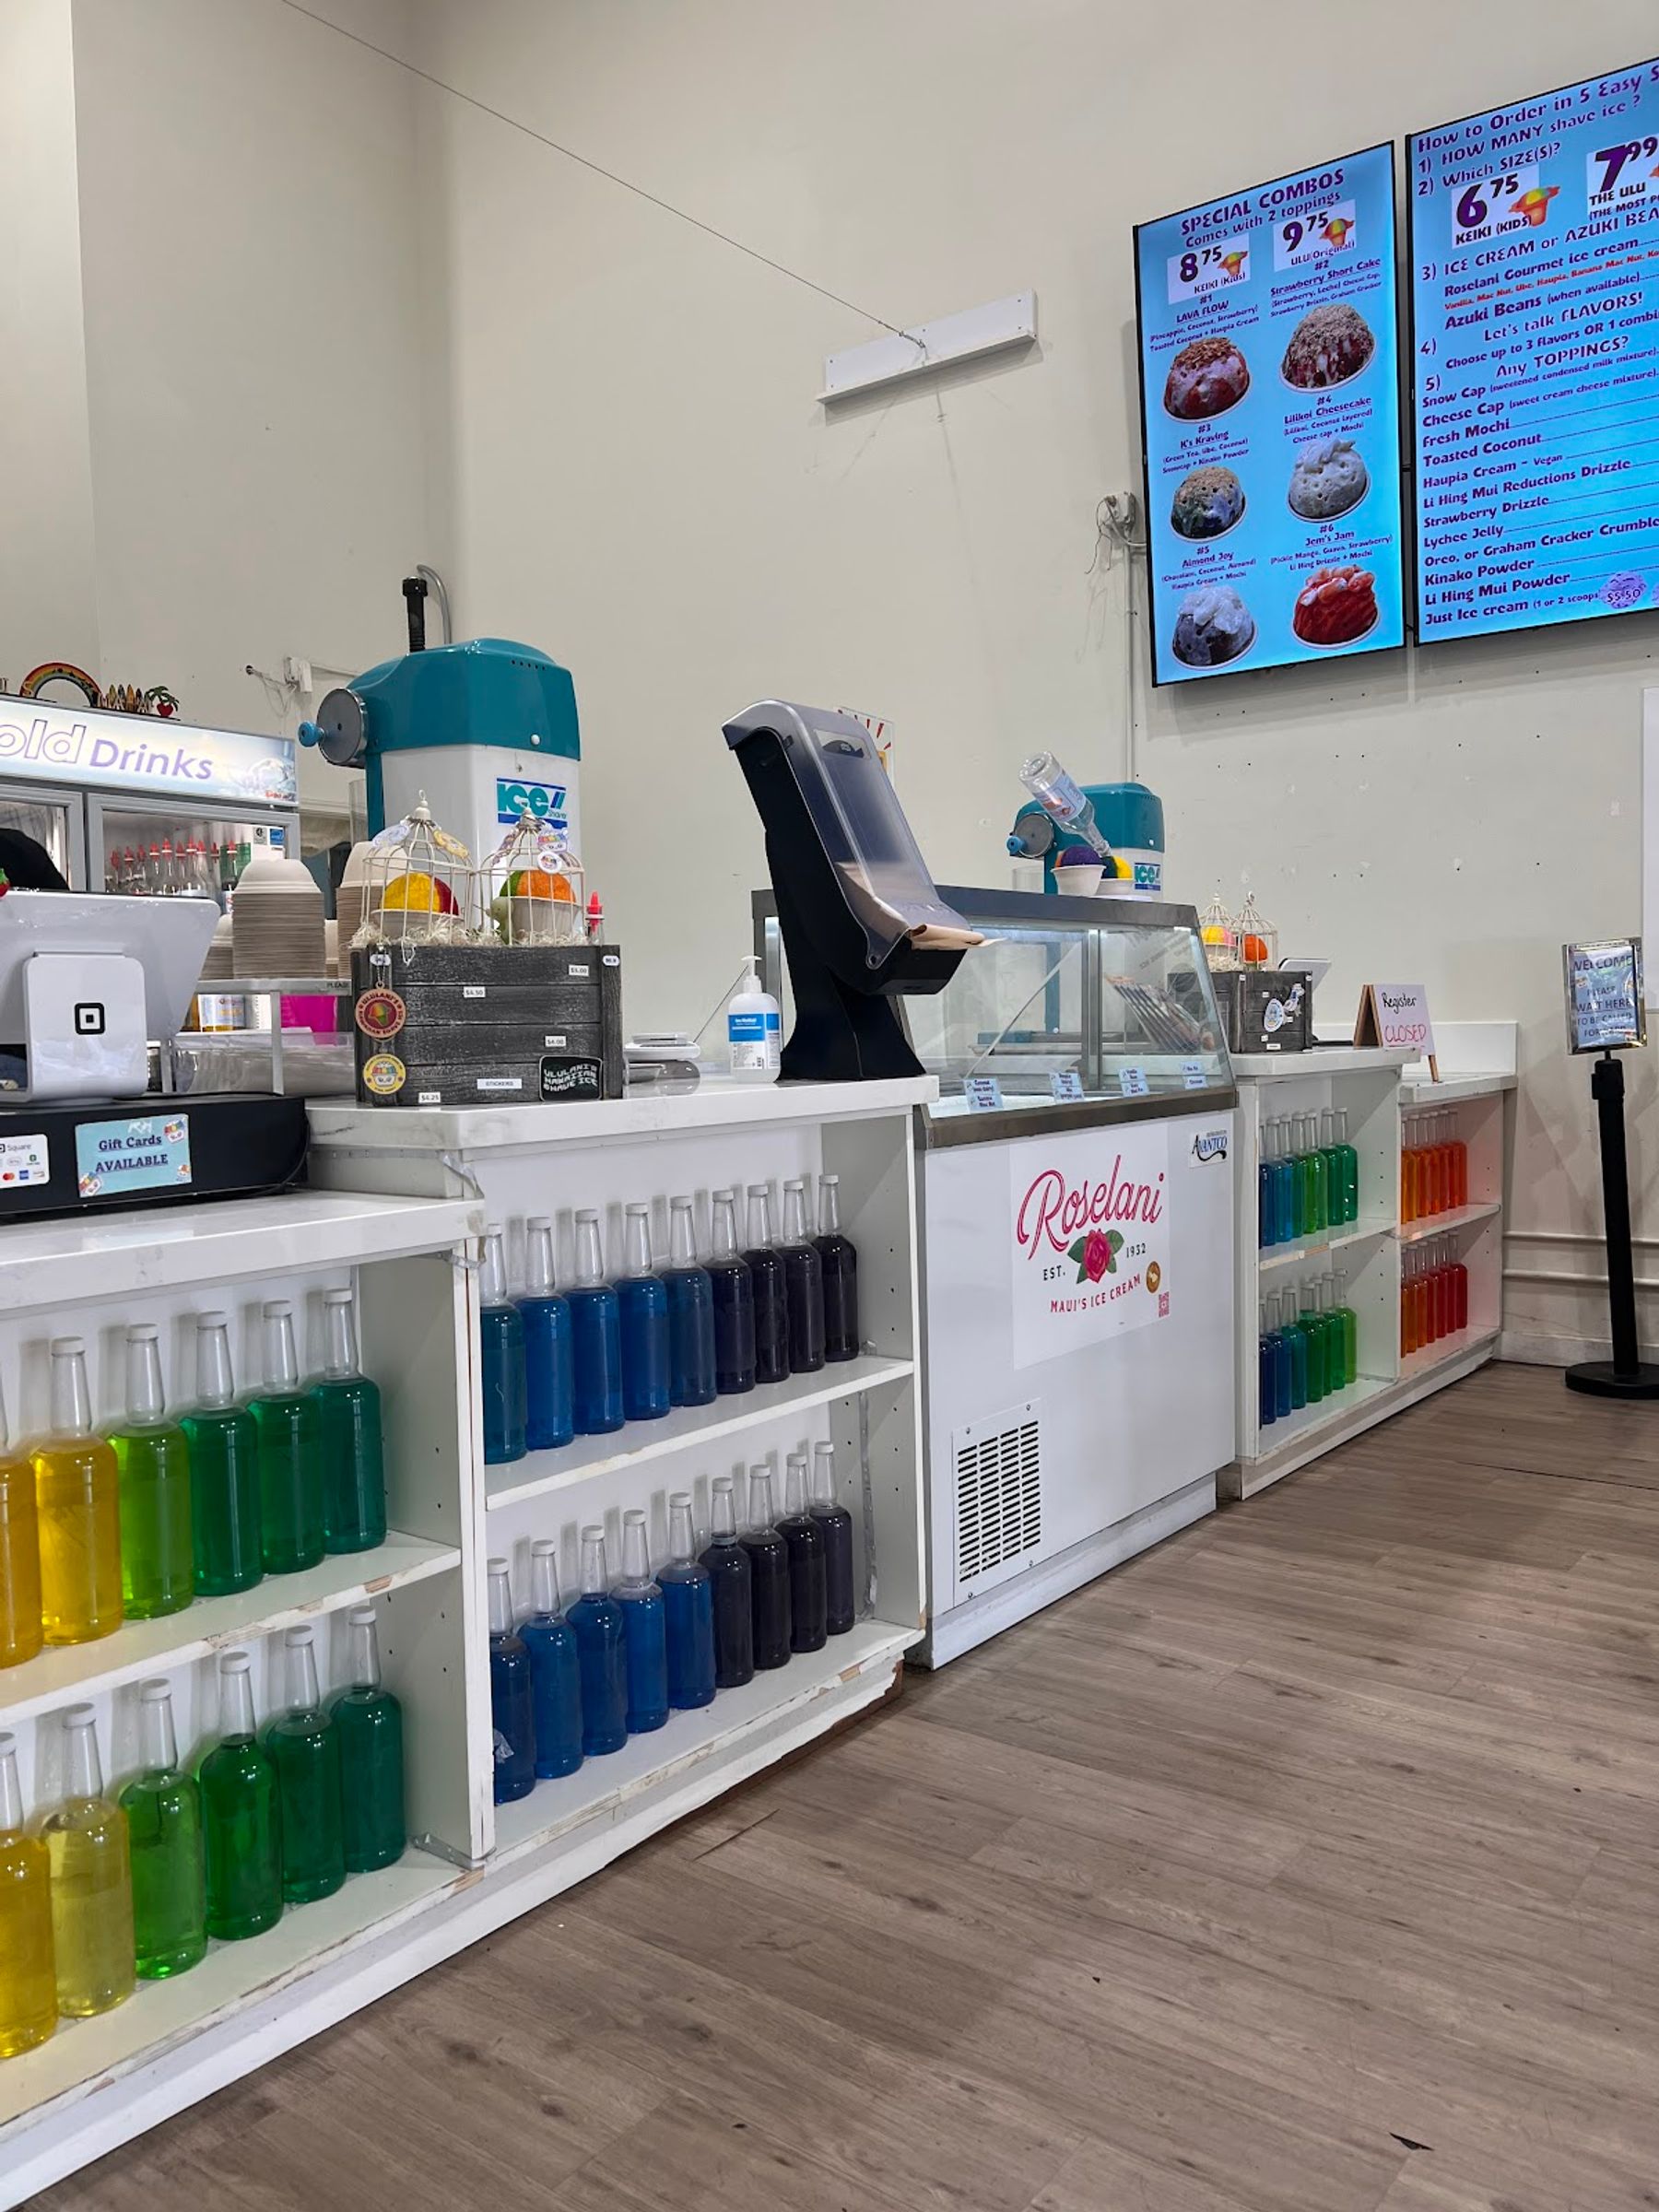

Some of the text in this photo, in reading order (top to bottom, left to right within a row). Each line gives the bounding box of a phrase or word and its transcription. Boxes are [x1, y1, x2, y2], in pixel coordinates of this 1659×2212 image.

[1418, 131, 1459, 153] How
[1465, 124, 1483, 138] to
[1489, 104, 1547, 129] Order
[1554, 97, 1571, 111] in
[1580, 87, 1590, 104] 5
[1598, 75, 1642, 97] Easy
[1418, 157, 1431, 173] 1)
[1441, 142, 1485, 166] HOW
[1491, 124, 1544, 150] MANY
[1549, 112, 1595, 133] shave
[1603, 102, 1626, 117] ice
[1418, 142, 1561, 196] 2) Which SIZE(S)?
[1181, 168, 1346, 236] SPECIAL COMBOS
[1589, 182, 1646, 206] THE ULU
[1589, 197, 1646, 221] (THE MOST
[1185, 189, 1341, 249] Comes with 2 toppings
[1455, 215, 1533, 245] KEIKI (KIDS)
[1314, 260, 1330, 271] #2
[1421, 263, 1437, 281] 3)
[1444, 258, 1469, 276] ICE
[1475, 240, 1535, 266] CREAM
[1541, 237, 1559, 249] or
[1565, 217, 1618, 243] AZUKI
[1270, 258, 1381, 296] Strawberry Short Cake
[1444, 239, 1639, 298] Roselani Gourmet ice cream
[1194, 279, 1218, 294] KEIKI
[1199, 294, 1213, 305] #1
[1444, 271, 1640, 330] Azuki Beans (when available)
[1176, 300, 1230, 324] LAVA FLOW
[1484, 291, 1642, 342] Let's talk FLAVORS!
[1420, 337, 1437, 356] 4)
[1445, 319, 1615, 370] Choose up to 3 flavors OR 1
[1495, 335, 1629, 379] Any TOPPINGS?
[1421, 392, 1457, 408] Snow
[1461, 385, 1486, 399] Cap
[1489, 374, 1539, 394] (sweetened
[1542, 363, 1590, 381] condensed
[1592, 358, 1614, 369] milk
[1425, 373, 1441, 392] 5)
[1315, 397, 1372, 417] Cheesecake
[1316, 394, 1332, 406] #4
[1422, 408, 1473, 428] Cheese
[1477, 401, 1505, 416] Cap
[1509, 394, 1541, 410] (sweet
[1542, 388, 1574, 402] cream
[1576, 378, 1610, 394] cheese
[1422, 418, 1511, 448] Fresh Mochi
[1423, 433, 1542, 467] Toasted Coconut
[1423, 453, 1564, 488] Haupia Cream Vegan
[1423, 461, 1632, 509] Li Hing Mui Reductions Drizzle
[1423, 495, 1550, 529] Strawberry Drizzle
[1334, 531, 1355, 540] Jam
[1424, 524, 1505, 549] Lychee Jelly
[1424, 552, 1460, 568] Oreo,
[1464, 548, 1479, 560] or
[1483, 538, 1536, 558] Graham
[1540, 526, 1594, 547] Cracker
[1424, 558, 1535, 587] Kinako Powder
[1425, 571, 1571, 606] Li Hing Mui Powder
[1425, 610, 1453, 626] Just
[1457, 606, 1478, 621] Ice
[1483, 599, 1529, 617] cream
[1533, 599, 1541, 610] (1
[1544, 598, 1556, 607] or
[1558, 595, 1564, 606] 2
[89, 738, 215, 780] Drinks
[1382, 992, 1418, 1015] Register
[1384, 1024, 1427, 1042] CLOSED
[99, 1135, 162, 1151] Gift Cards
[96, 1154, 169, 1173] AVAILABLE
[1017, 1154, 1165, 1261] Roselani
[1042, 1265, 1066, 1281] EST.
[1050, 1274, 1141, 1314] MAUI'S ICE CREAM
